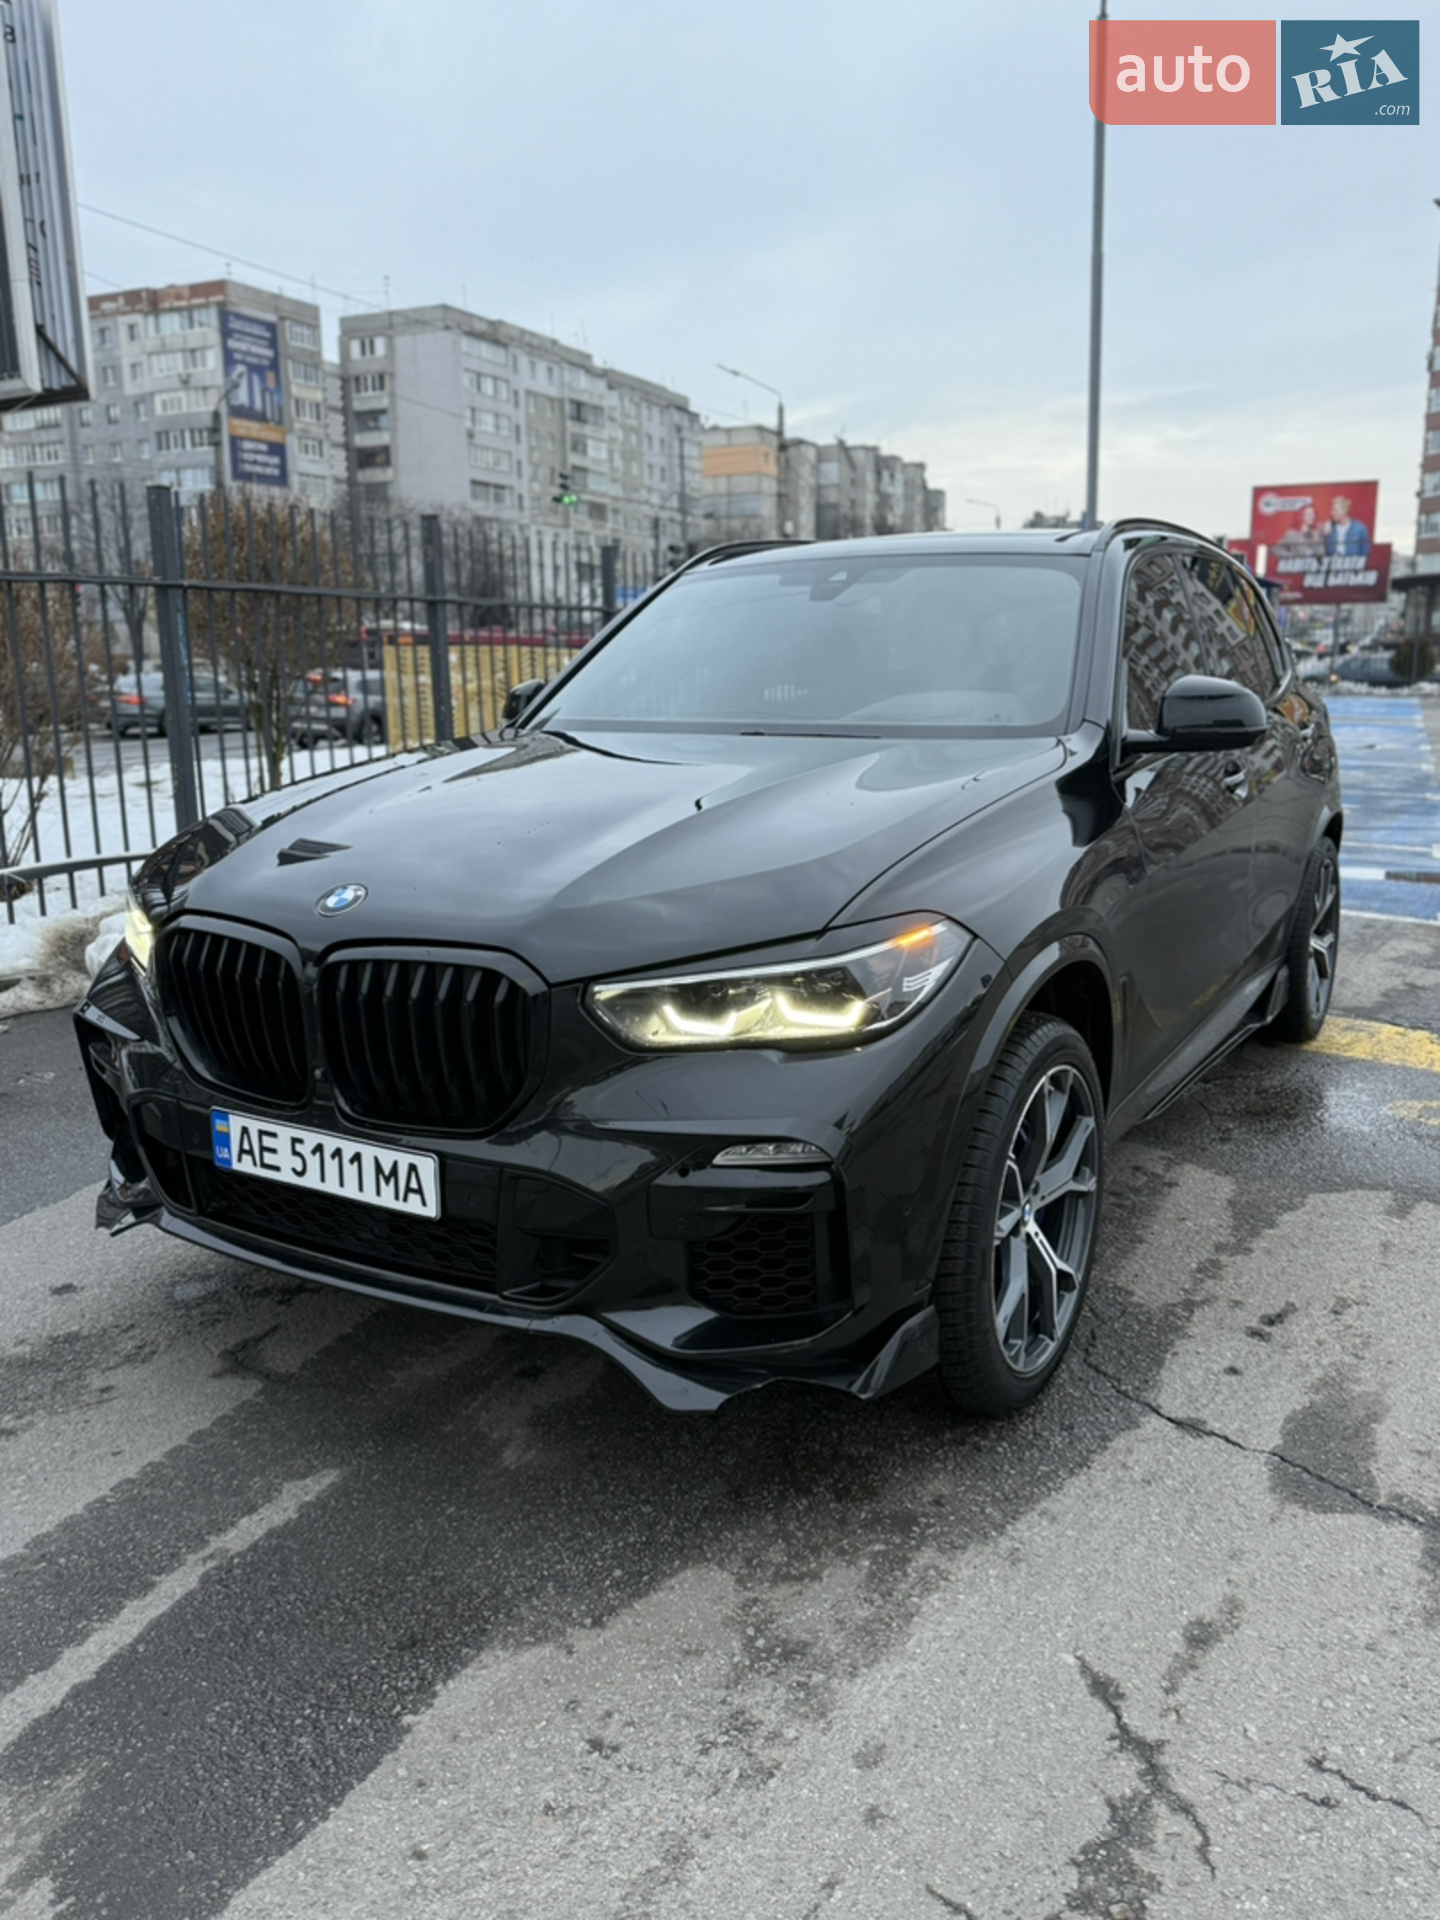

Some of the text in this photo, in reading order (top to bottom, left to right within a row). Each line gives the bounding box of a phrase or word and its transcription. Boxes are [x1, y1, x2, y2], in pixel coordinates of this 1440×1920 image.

[216, 1145, 230, 1160] UA
[237, 1125, 428, 1207] AE 5111 MA
